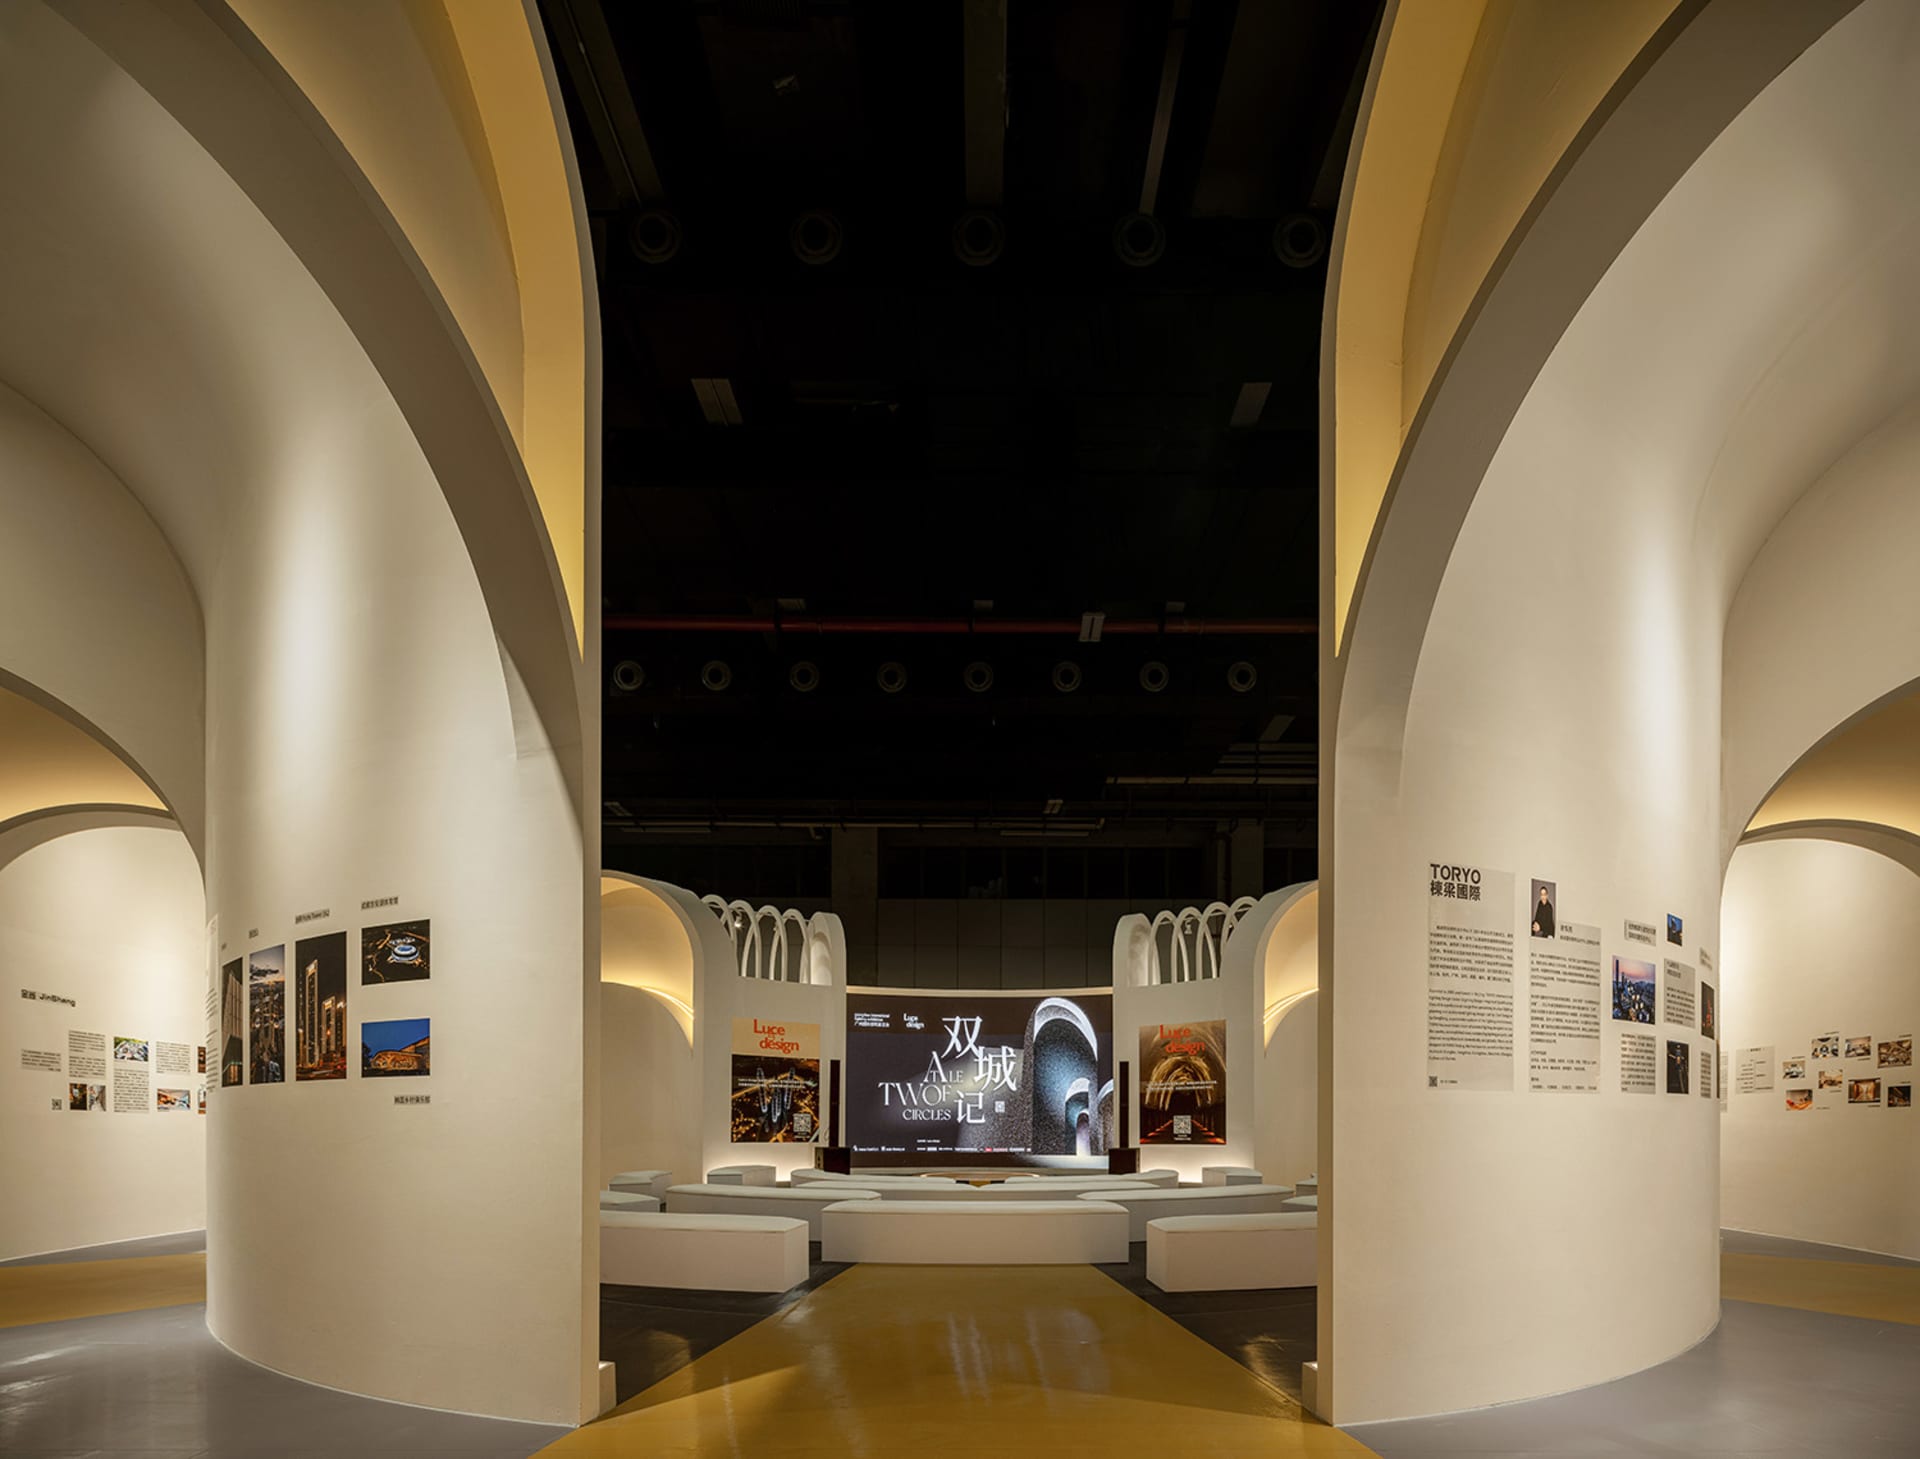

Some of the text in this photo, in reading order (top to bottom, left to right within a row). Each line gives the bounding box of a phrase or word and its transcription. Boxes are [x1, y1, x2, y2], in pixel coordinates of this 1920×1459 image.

[1430, 863, 1481, 884] TORYO
[753, 1019, 785, 1035] Luce
[1160, 1024, 1191, 1039] Luce
[759, 1037, 799, 1054] design
[1165, 1040, 1205, 1055] design
[902, 1109, 951, 1121] CIRCLES
